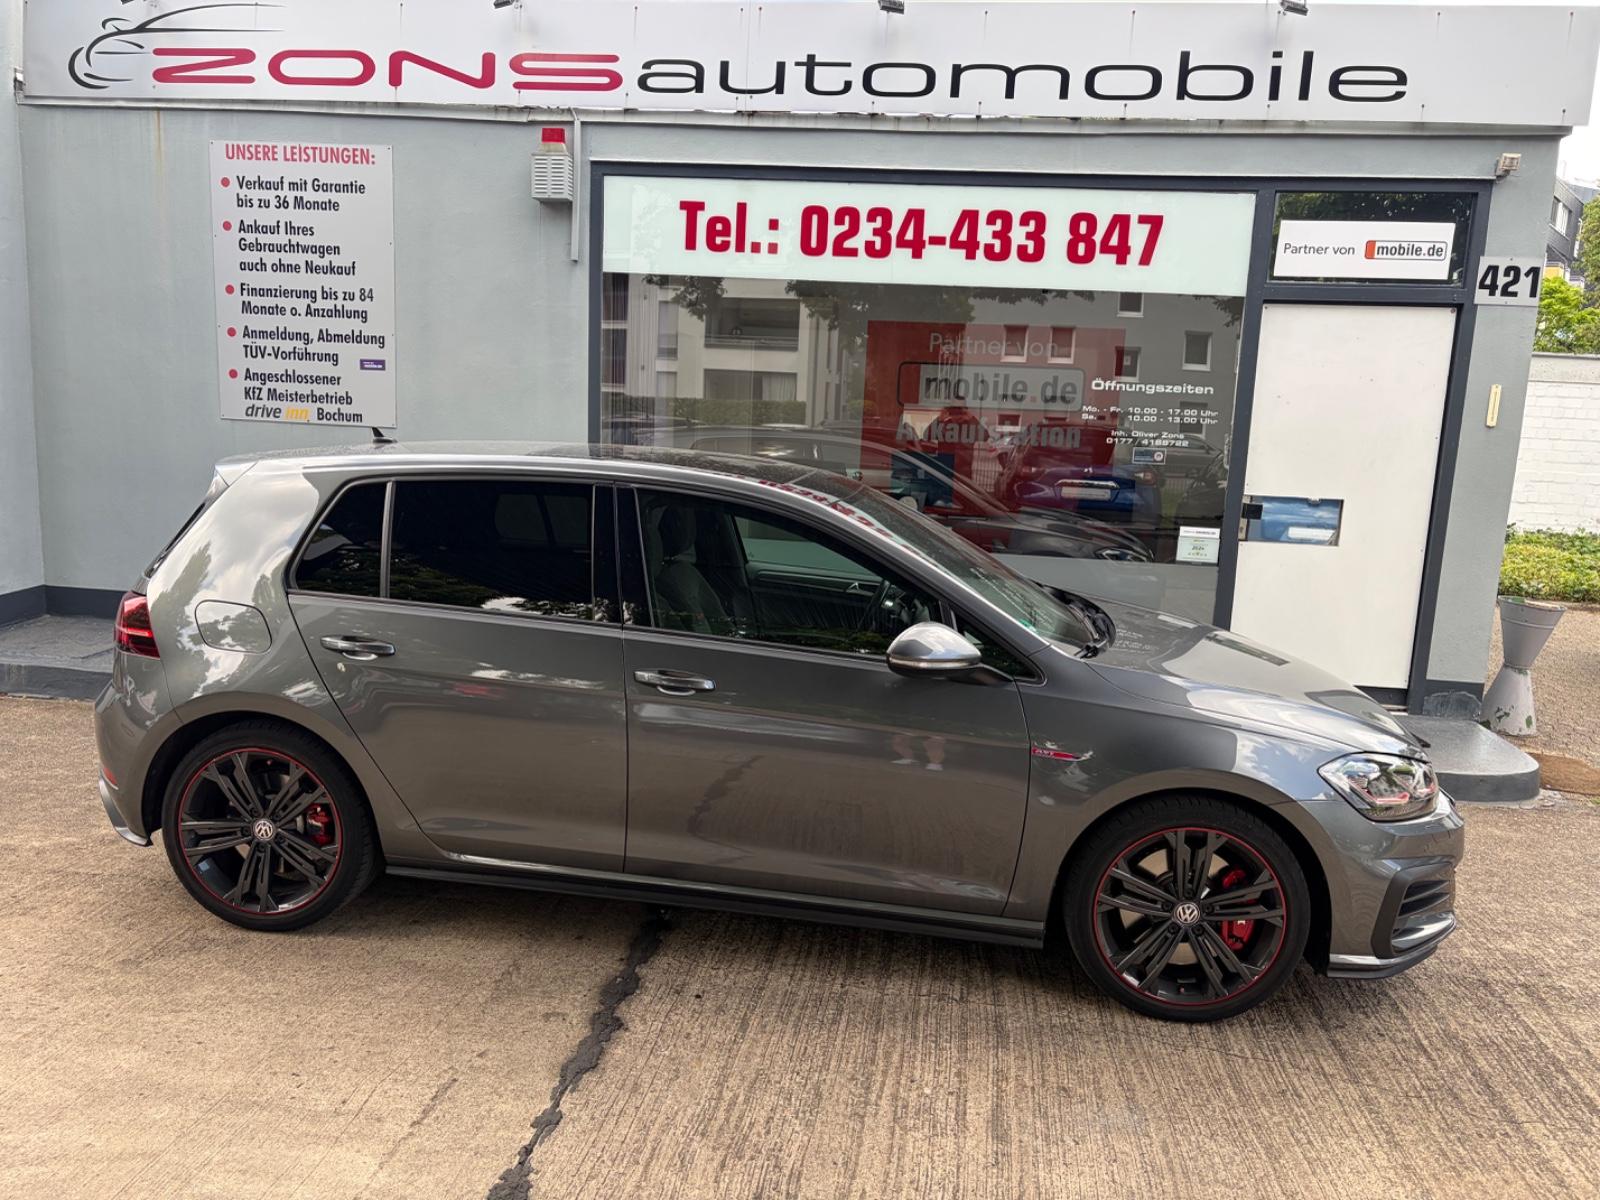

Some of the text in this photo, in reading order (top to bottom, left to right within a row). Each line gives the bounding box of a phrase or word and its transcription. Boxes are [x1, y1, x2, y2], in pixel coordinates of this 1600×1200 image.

[225, 143, 376, 165] UNSERE LEISTUNGEN:
[236, 176, 366, 194] Verkauf mit Garantie
[236, 193, 340, 212] bis zu 36 Monate
[238, 219, 315, 236] Ankauf Ihres
[680, 200, 1164, 267] Tel.: 0234-433 847
[238, 237, 341, 258] Gebrauchtwagen
[1283, 242, 1444, 257] Partner von mobile.de
[239, 258, 356, 276] auch ohne Neukauf
[1478, 265, 1541, 298] 421
[240, 283, 374, 304] Finanzierung bis zu 84
[241, 301, 368, 323] Monate o. Anzahlung
[242, 325, 386, 348] Anmeldung, Abmeldung
[929, 333, 1059, 357] Partner von
[242, 341, 339, 366] TÜV-Vorführung
[244, 367, 342, 386] Angeschlossener
[1091, 377, 1214, 394] Öffnungszeiten
[244, 386, 353, 405] KfZ Meisterbetrieb
[924, 372, 1078, 403] mobile.de
[245, 404, 282, 418] drive
[317, 408, 363, 422] Bochum
[1127, 407, 1158, 415] 10.00
[1168, 408, 1198, 416] 17.00
[1200, 409, 1219, 417] Uhr
[1167, 416, 1198, 424] 13.00
[1200, 417, 1218, 425] Uhr
